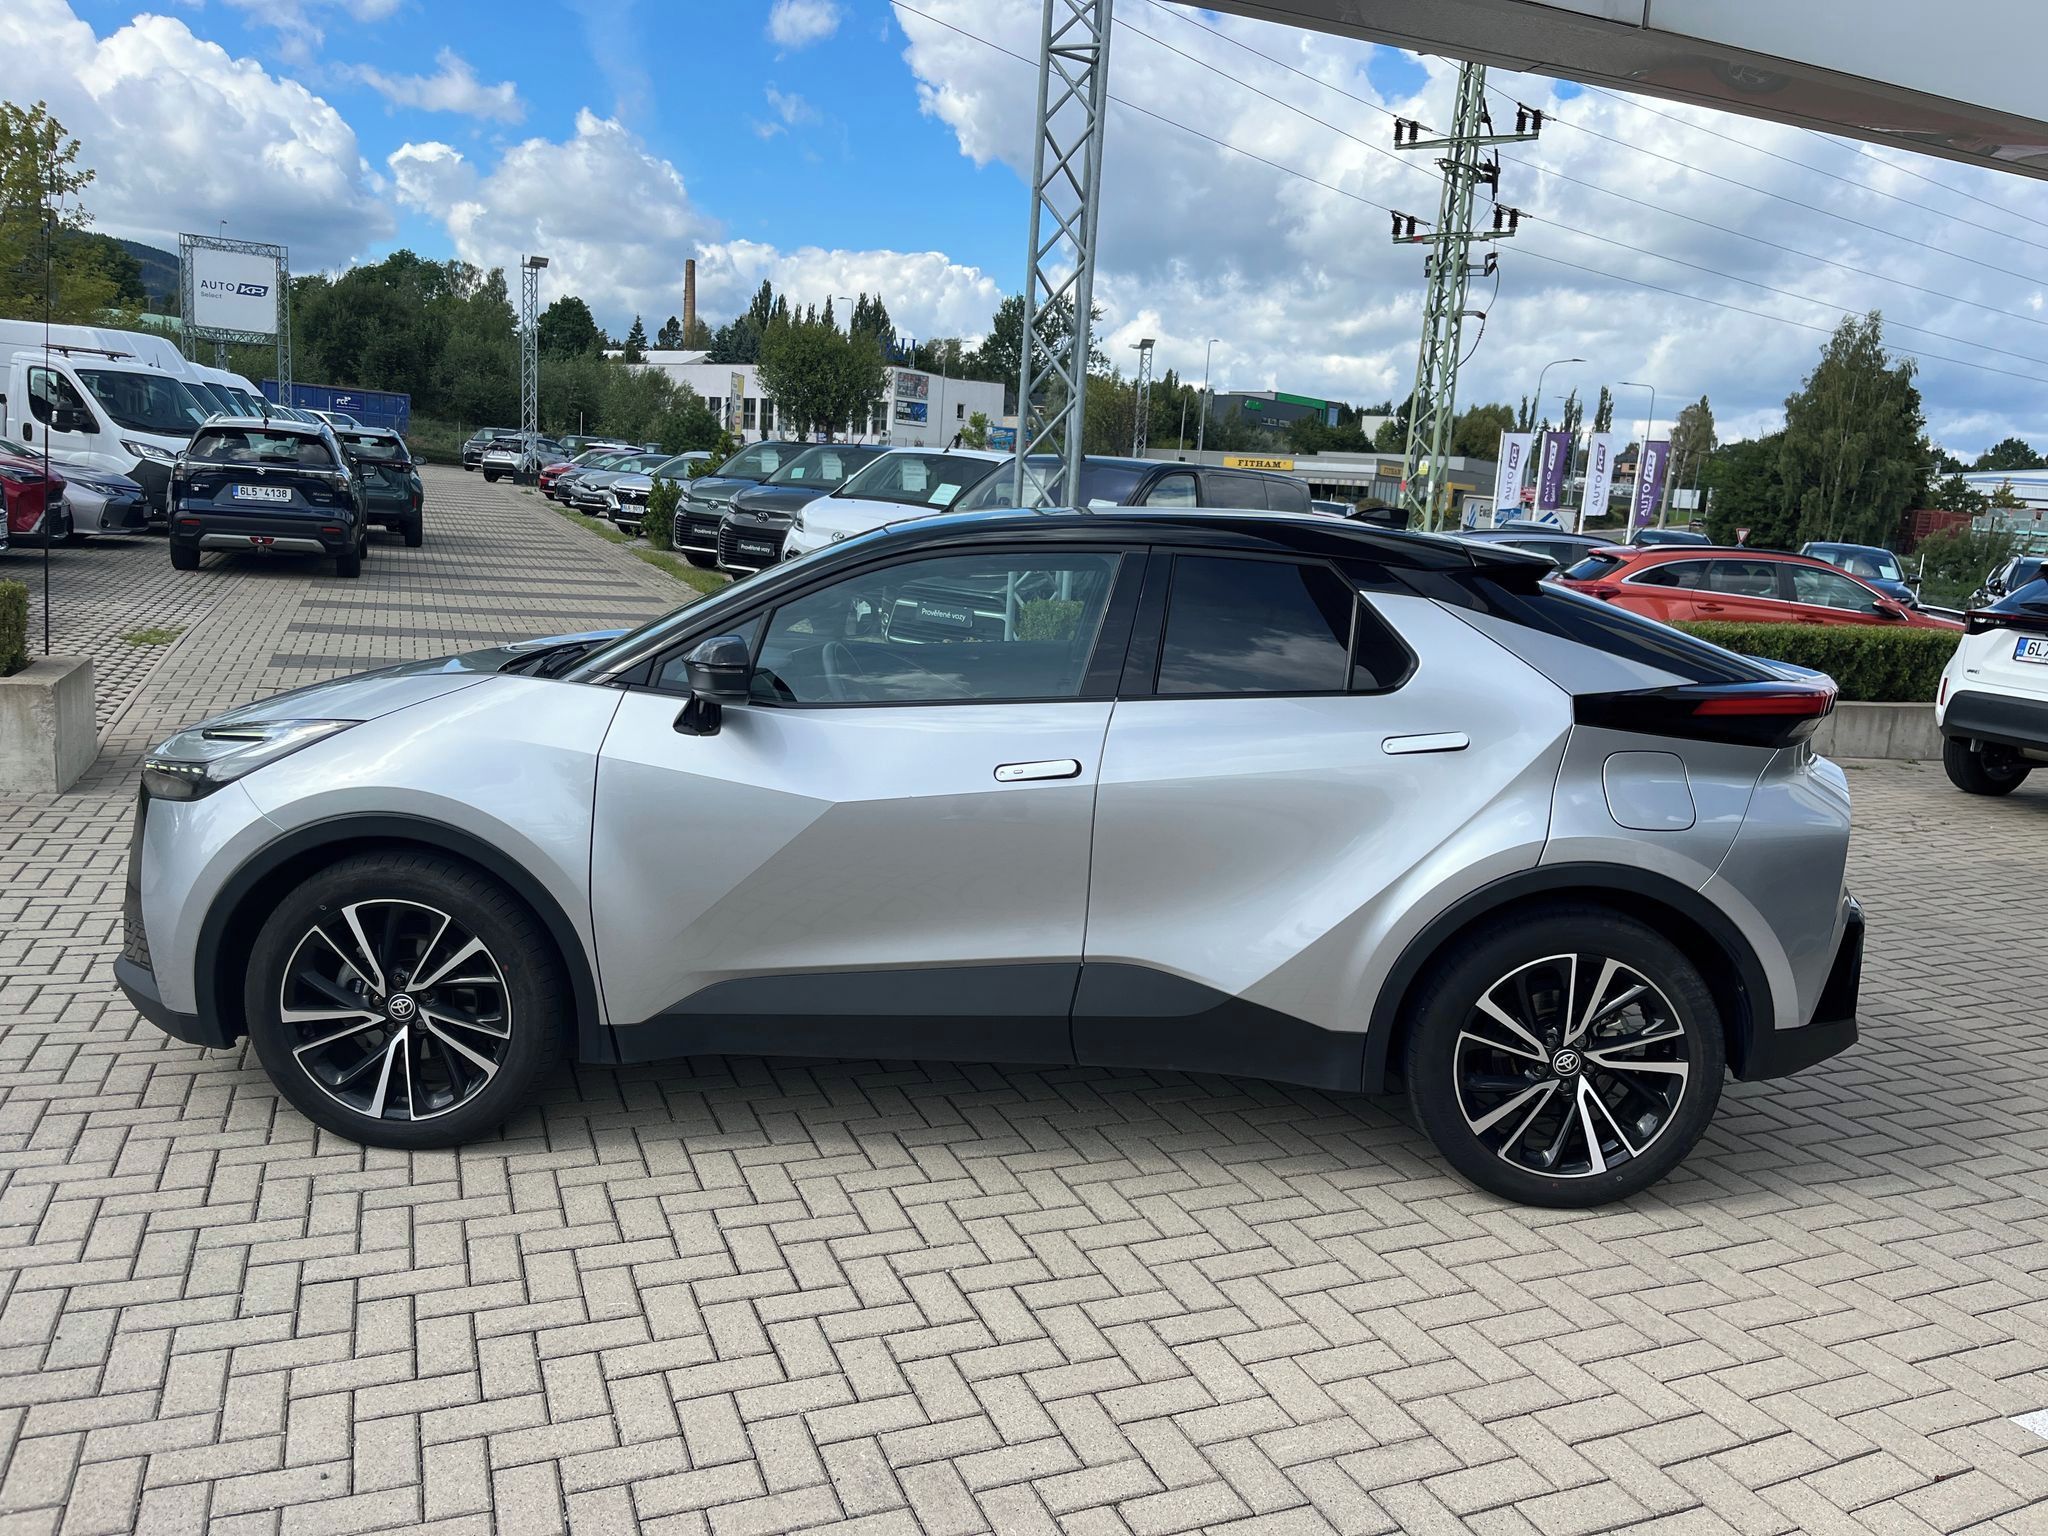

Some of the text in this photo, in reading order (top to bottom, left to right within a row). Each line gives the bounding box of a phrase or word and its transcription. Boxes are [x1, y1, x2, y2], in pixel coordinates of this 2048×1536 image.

[200, 280, 235, 292] AUTO
[200, 291, 222, 299] Select
[1238, 459, 1281, 468] FITHAM
[1504, 471, 1514, 500] AUTO
[1592, 475, 1603, 507] AUTO
[240, 486, 257, 497] 6L5
[264, 488, 287, 498] 4138
[1640, 483, 1651, 517] AUTO
[951, 612, 967, 622] vozy
